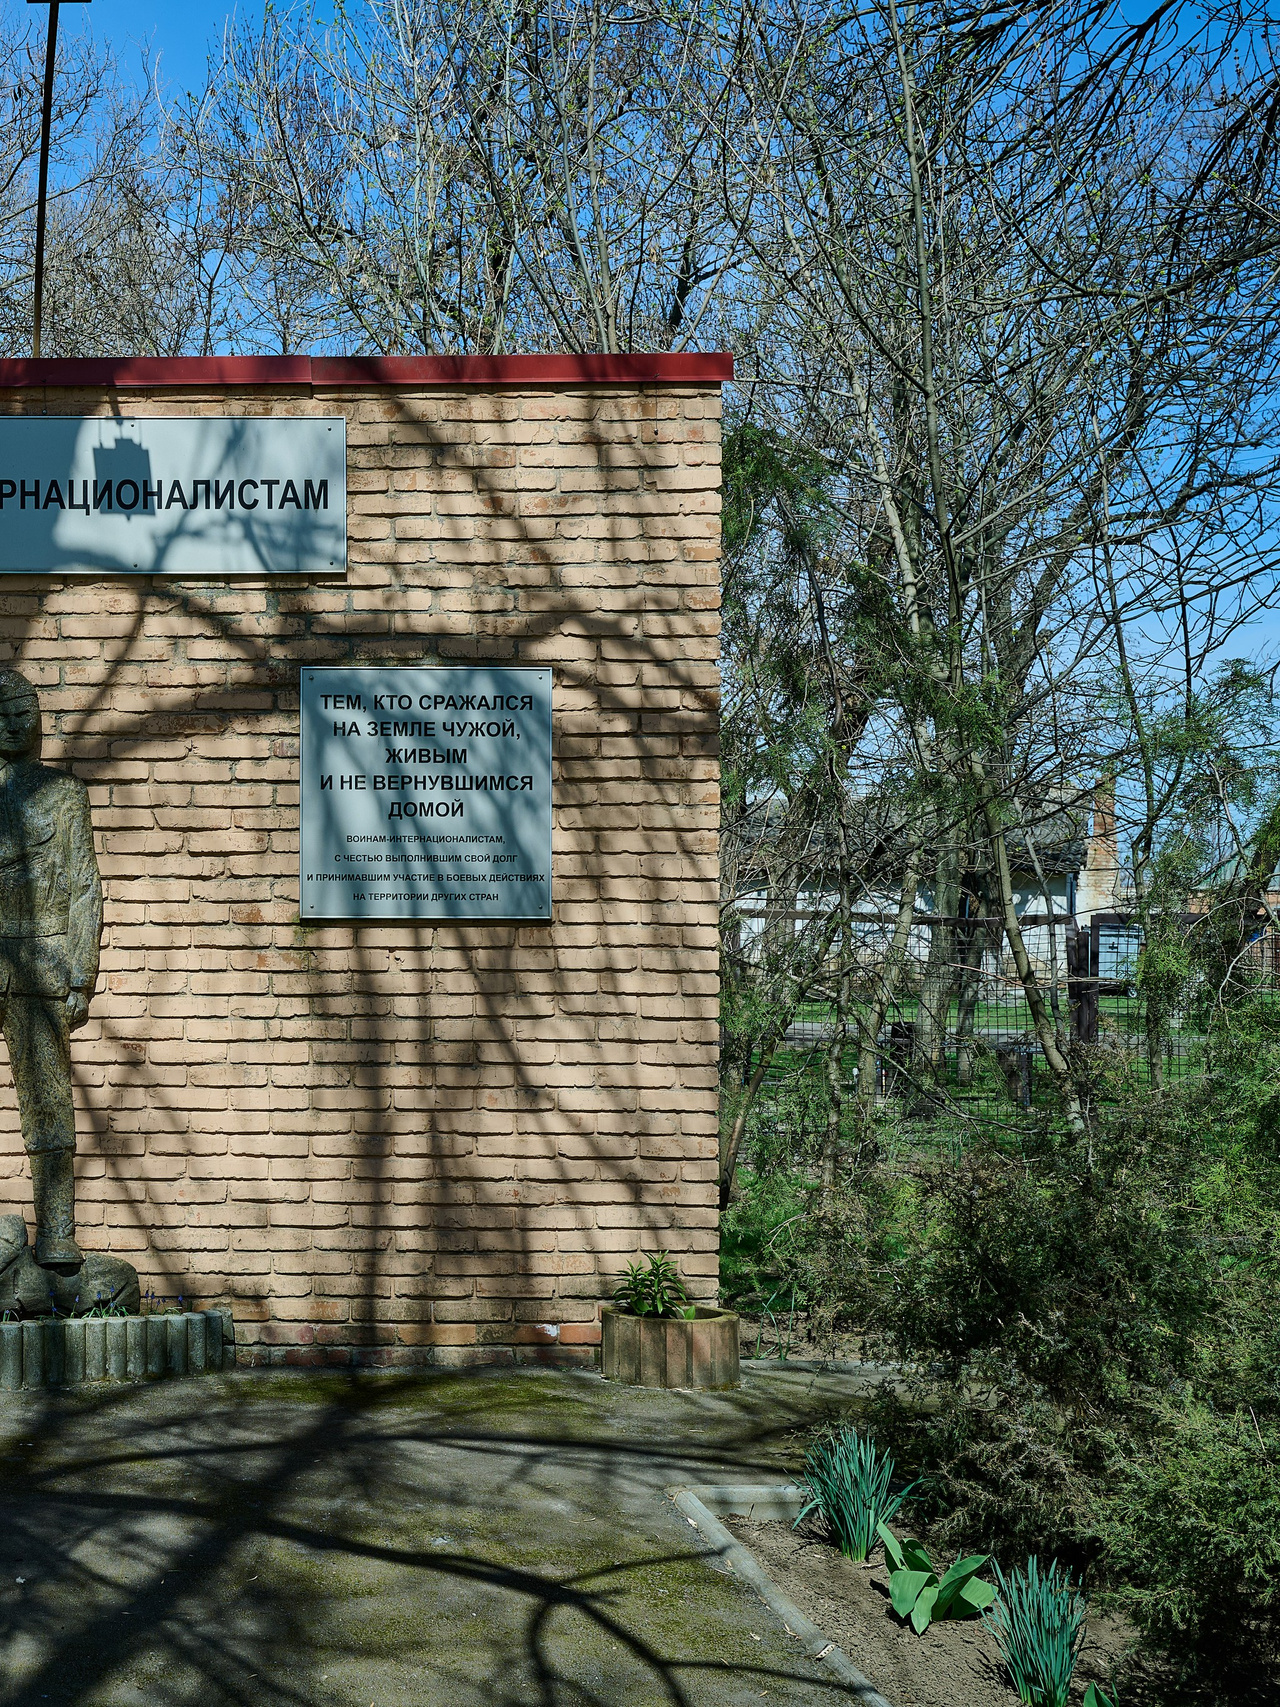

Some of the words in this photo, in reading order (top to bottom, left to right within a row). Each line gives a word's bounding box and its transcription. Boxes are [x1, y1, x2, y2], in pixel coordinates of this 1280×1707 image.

[320, 694, 367, 713] ТЕМ,
[374, 694, 413, 711] КТО
[418, 694, 533, 711] СРАЖАЛСЯ
[333, 721, 361, 737] НА
[367, 721, 436, 737] ЗЕМЛЕ
[442, 718, 520, 740] ЧУЖОЙ,
[385, 748, 467, 764] ЖИВЫМ
[320, 775, 333, 791] И
[340, 775, 367, 791] НЕ
[373, 775, 533, 791] ВЕРНУВШИМСЯ
[388, 799, 464, 820] ДОМОЙ
[346, 835, 506, 844] ВОИНАМ-ИНТЕРНАЦИОНАЛИСТАМ,
[334, 854, 341, 862] С
[343, 854, 383, 862] ЧЕСТЬЮ
[386, 854, 462, 862] ВЫПОЛНИВШИМ
[464, 853, 491, 862] СВОЙ
[492, 854, 518, 863] ДОЛГ
[488, 872, 545, 882] ДЕЙСТВИЯХ
[353, 893, 366, 901] НА
[368, 893, 429, 901] ТЕРРИТОРИИ
[431, 893, 467, 902] ДРУГИХ
[468, 893, 499, 901] СТРАН
